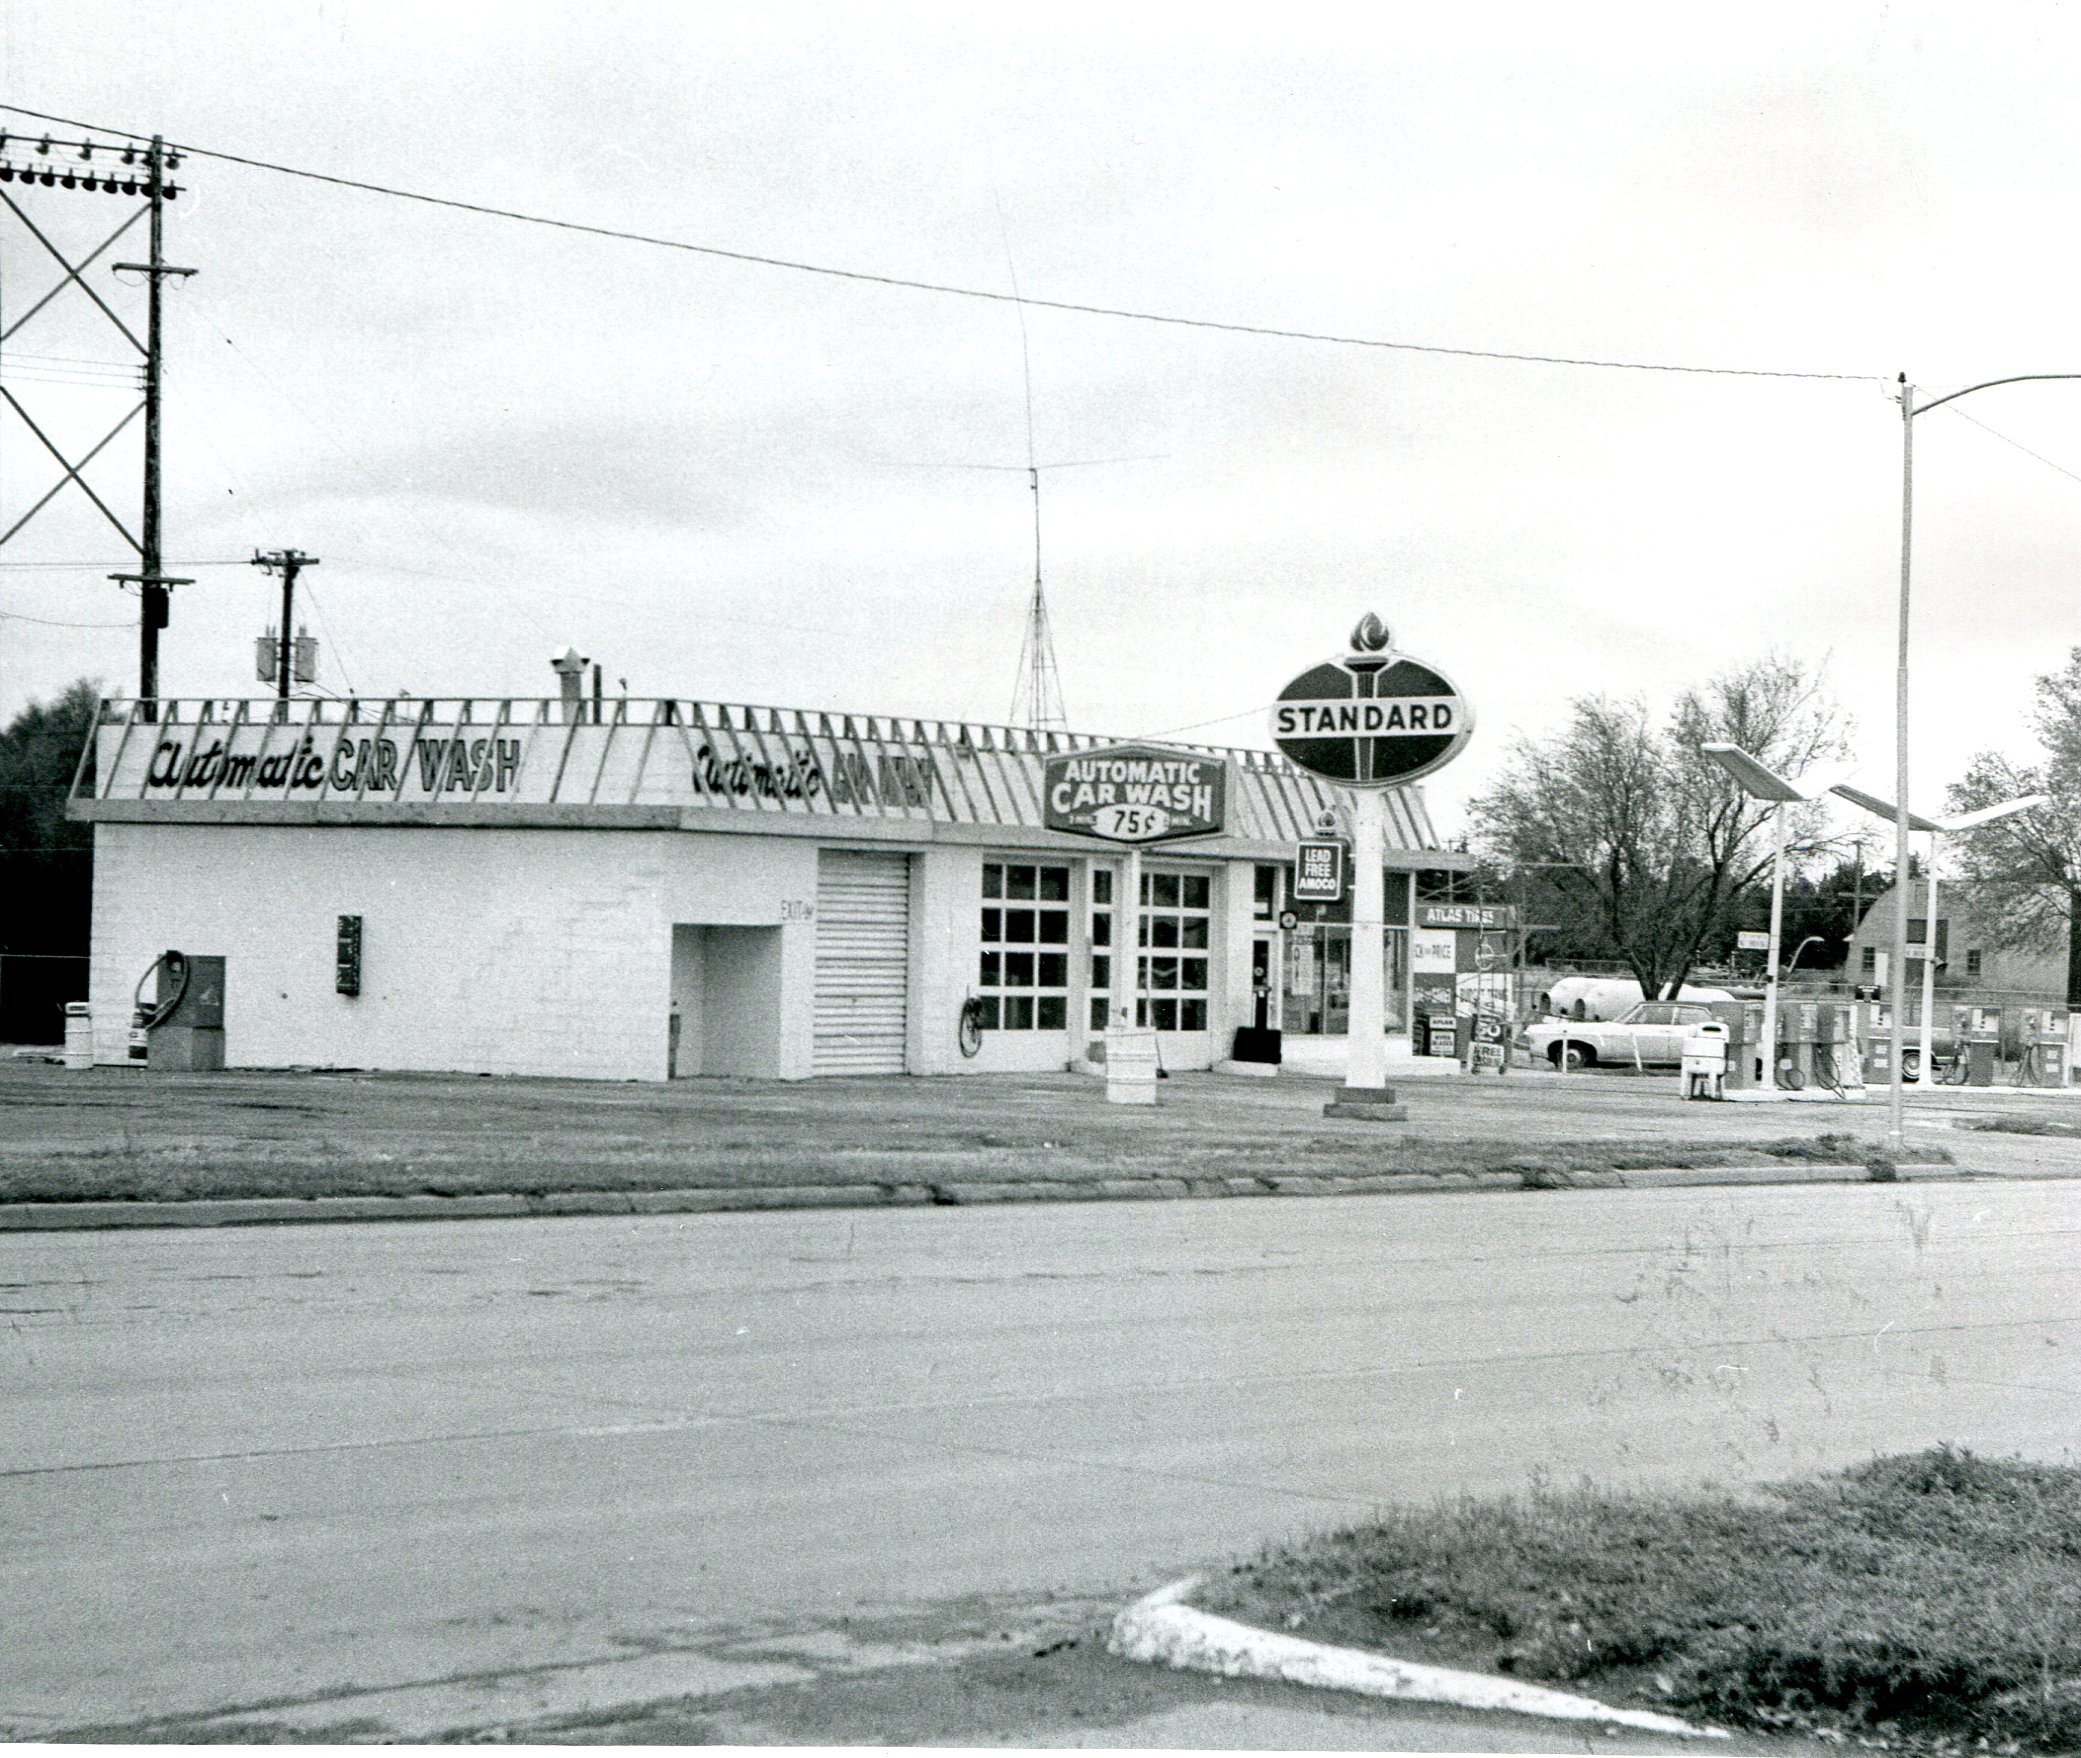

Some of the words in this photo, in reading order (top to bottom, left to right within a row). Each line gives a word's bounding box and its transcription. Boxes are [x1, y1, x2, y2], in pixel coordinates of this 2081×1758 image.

[1278, 704, 1452, 732] STANDARD
[330, 738, 398, 791] CAR
[416, 739, 520, 793] WASH
[1064, 760, 1201, 784] AUTOMATIC
[1051, 782, 1116, 814] CAR
[1125, 784, 1212, 822] WASH
[1114, 810, 1155, 834] 75¢
[1305, 848, 1332, 863] LEAD
[1304, 863, 1331, 877] FREE
[1298, 877, 1336, 890] AMOCO
[1427, 908, 1462, 922] ATLAS
